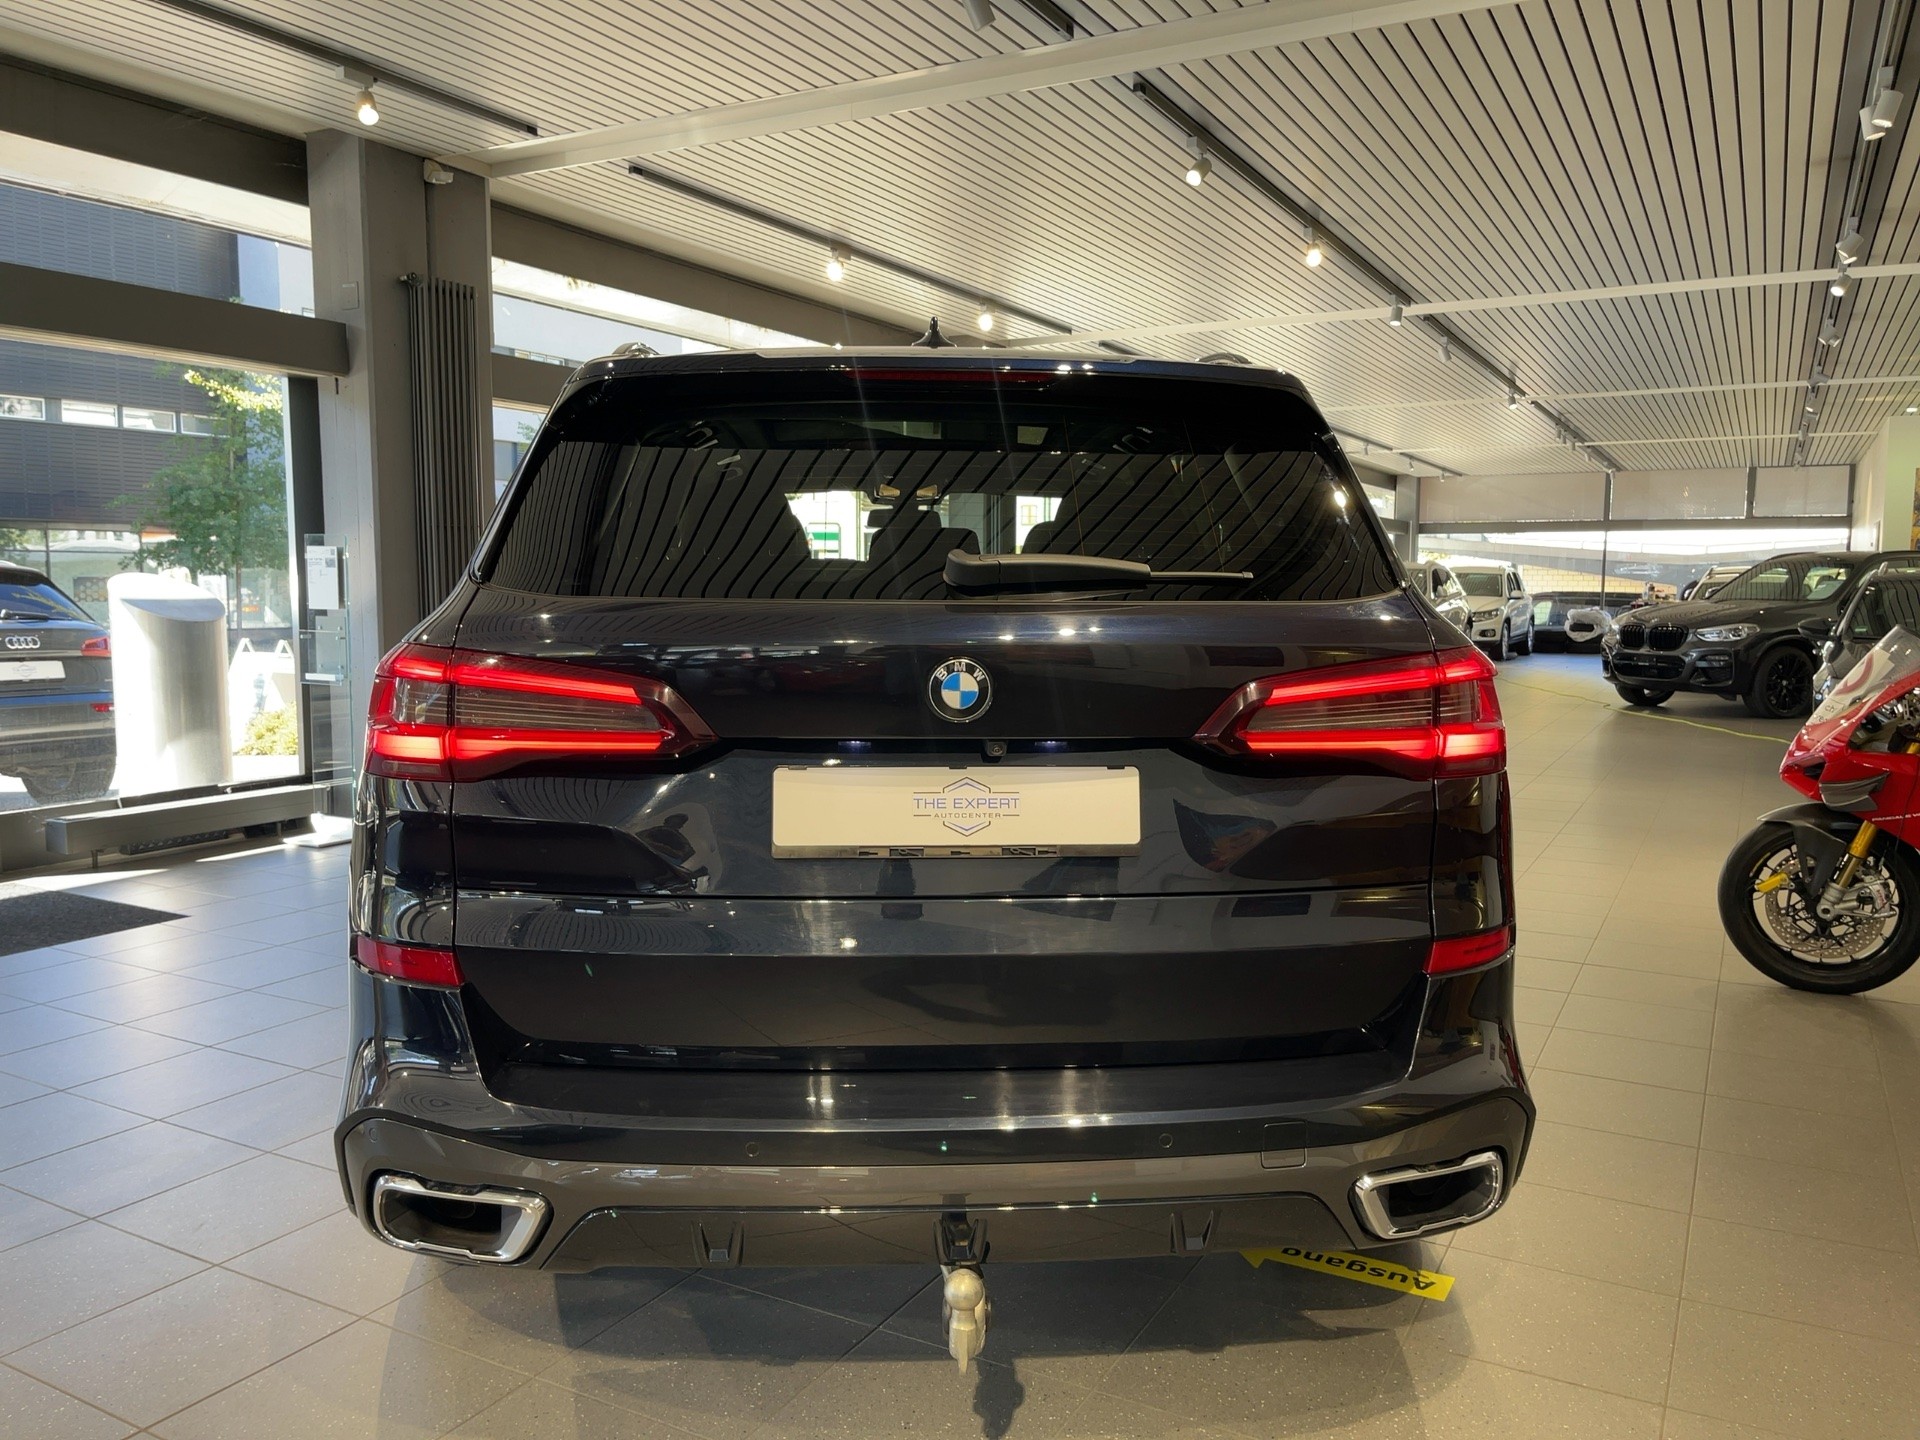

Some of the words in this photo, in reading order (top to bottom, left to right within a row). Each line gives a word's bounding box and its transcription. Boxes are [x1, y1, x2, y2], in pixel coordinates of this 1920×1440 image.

[935, 661, 986, 682] BMW
[913, 798, 947, 809] THE
[953, 798, 1020, 809] EXPERT
